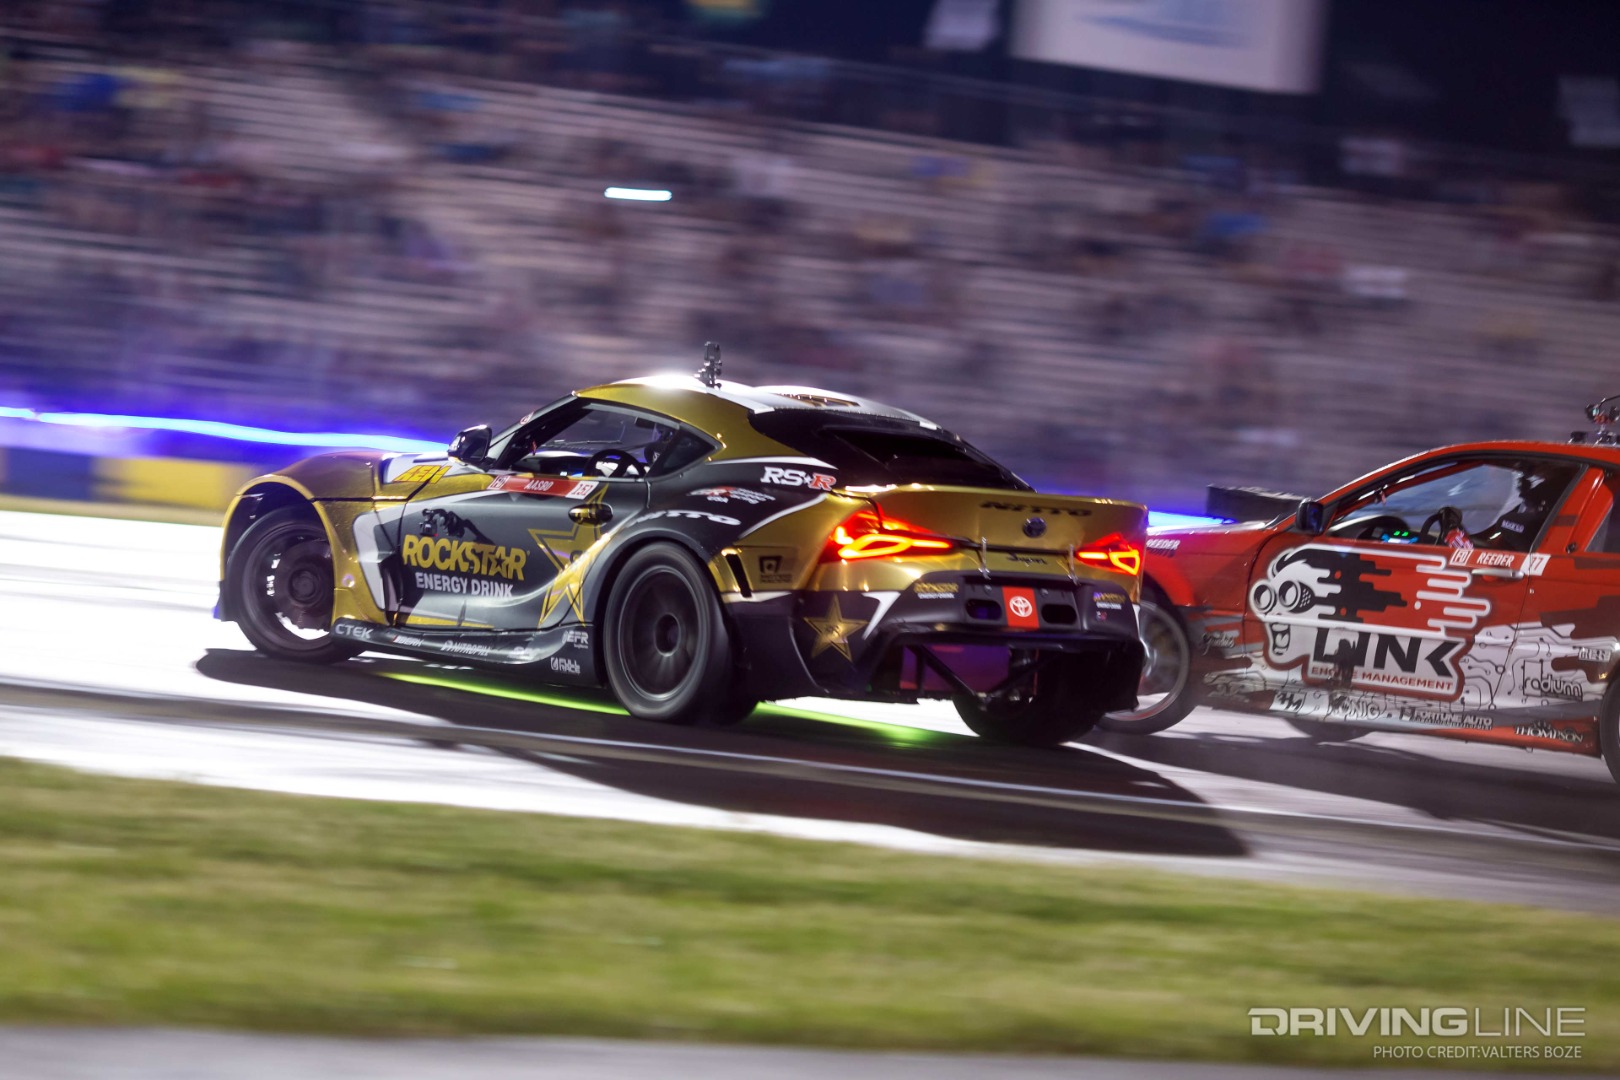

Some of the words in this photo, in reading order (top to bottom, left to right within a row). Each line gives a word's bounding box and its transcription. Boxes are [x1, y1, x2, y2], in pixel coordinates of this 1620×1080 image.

[524, 479, 554, 491] AASBO
[571, 484, 593, 496] 151
[1146, 538, 1181, 550] REEDER
[402, 534, 526, 581] ROCKSTAR
[1476, 552, 1515, 567] REEDER
[415, 572, 468, 594] ENERGY
[471, 580, 515, 599] DRINK
[334, 623, 375, 640] CTEK
[1313, 627, 1460, 678] LINK
[1311, 666, 1358, 680] ENGE
[1362, 672, 1454, 691] MANAGEMENT
[1524, 674, 1582, 697] radium
[1415, 710, 1462, 722] FORTUNE
[1463, 714, 1493, 726] AUTO
[1515, 726, 1584, 743] THOMPSON
